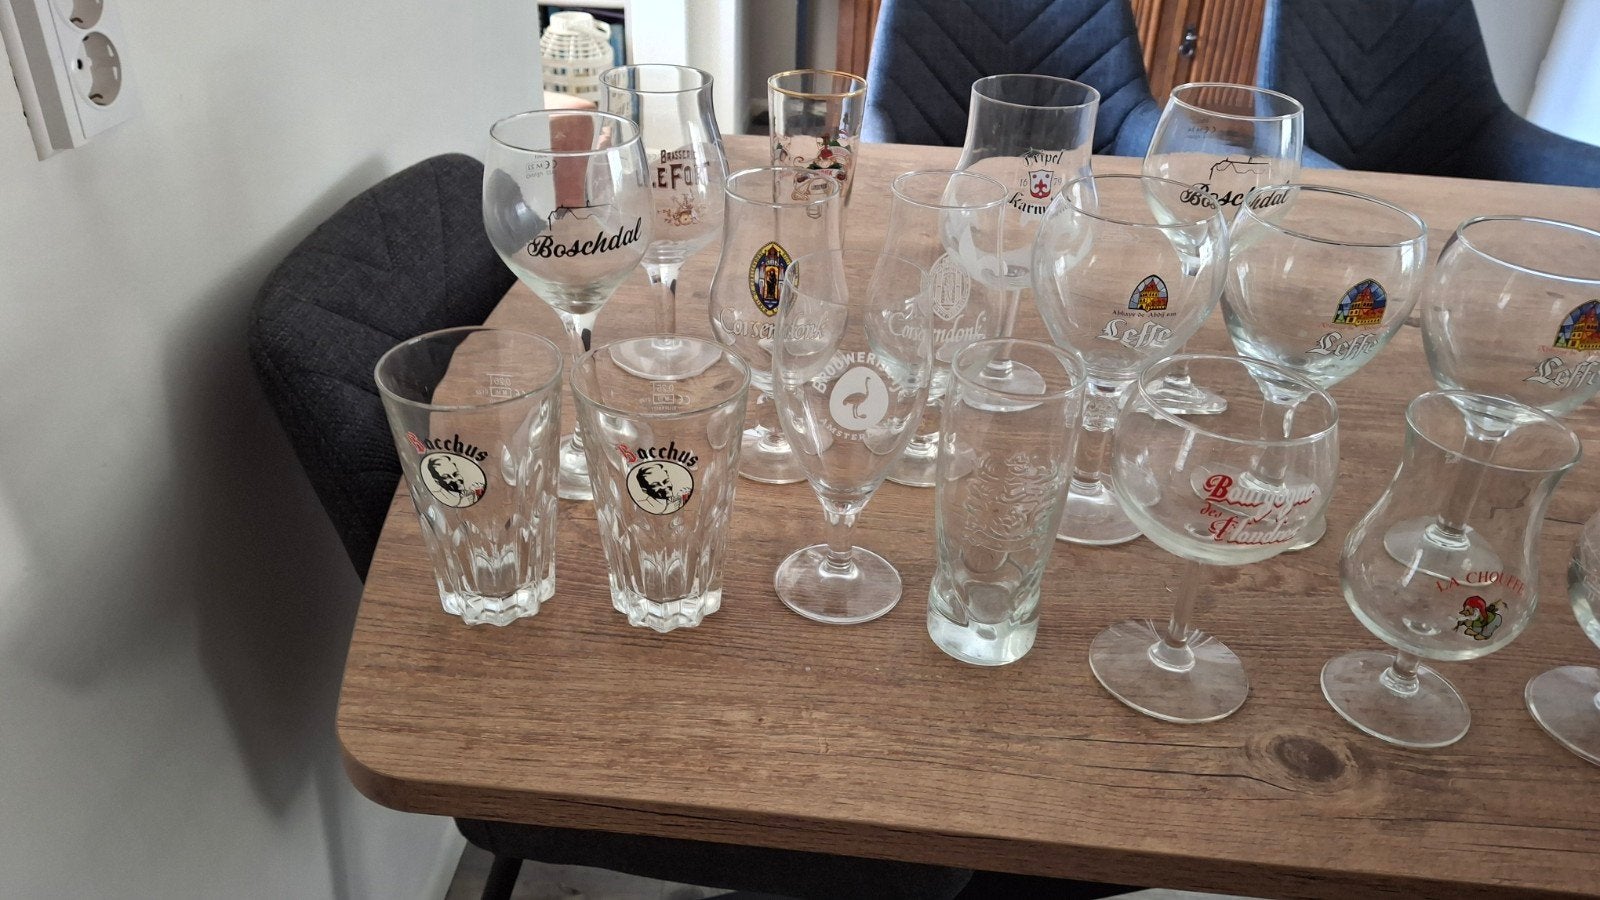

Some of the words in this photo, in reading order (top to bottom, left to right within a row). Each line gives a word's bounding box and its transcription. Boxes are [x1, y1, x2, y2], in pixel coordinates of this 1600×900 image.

[527, 216, 642, 258] Boschdal
[1096, 319, 1173, 350] Leffe
[1305, 331, 1379, 361] Leffe
[407, 431, 489, 461] Bacchus
[616, 441, 699, 467] Bacchus
[1200, 502, 1222, 518] des
[1436, 577, 1460, 593] LA
